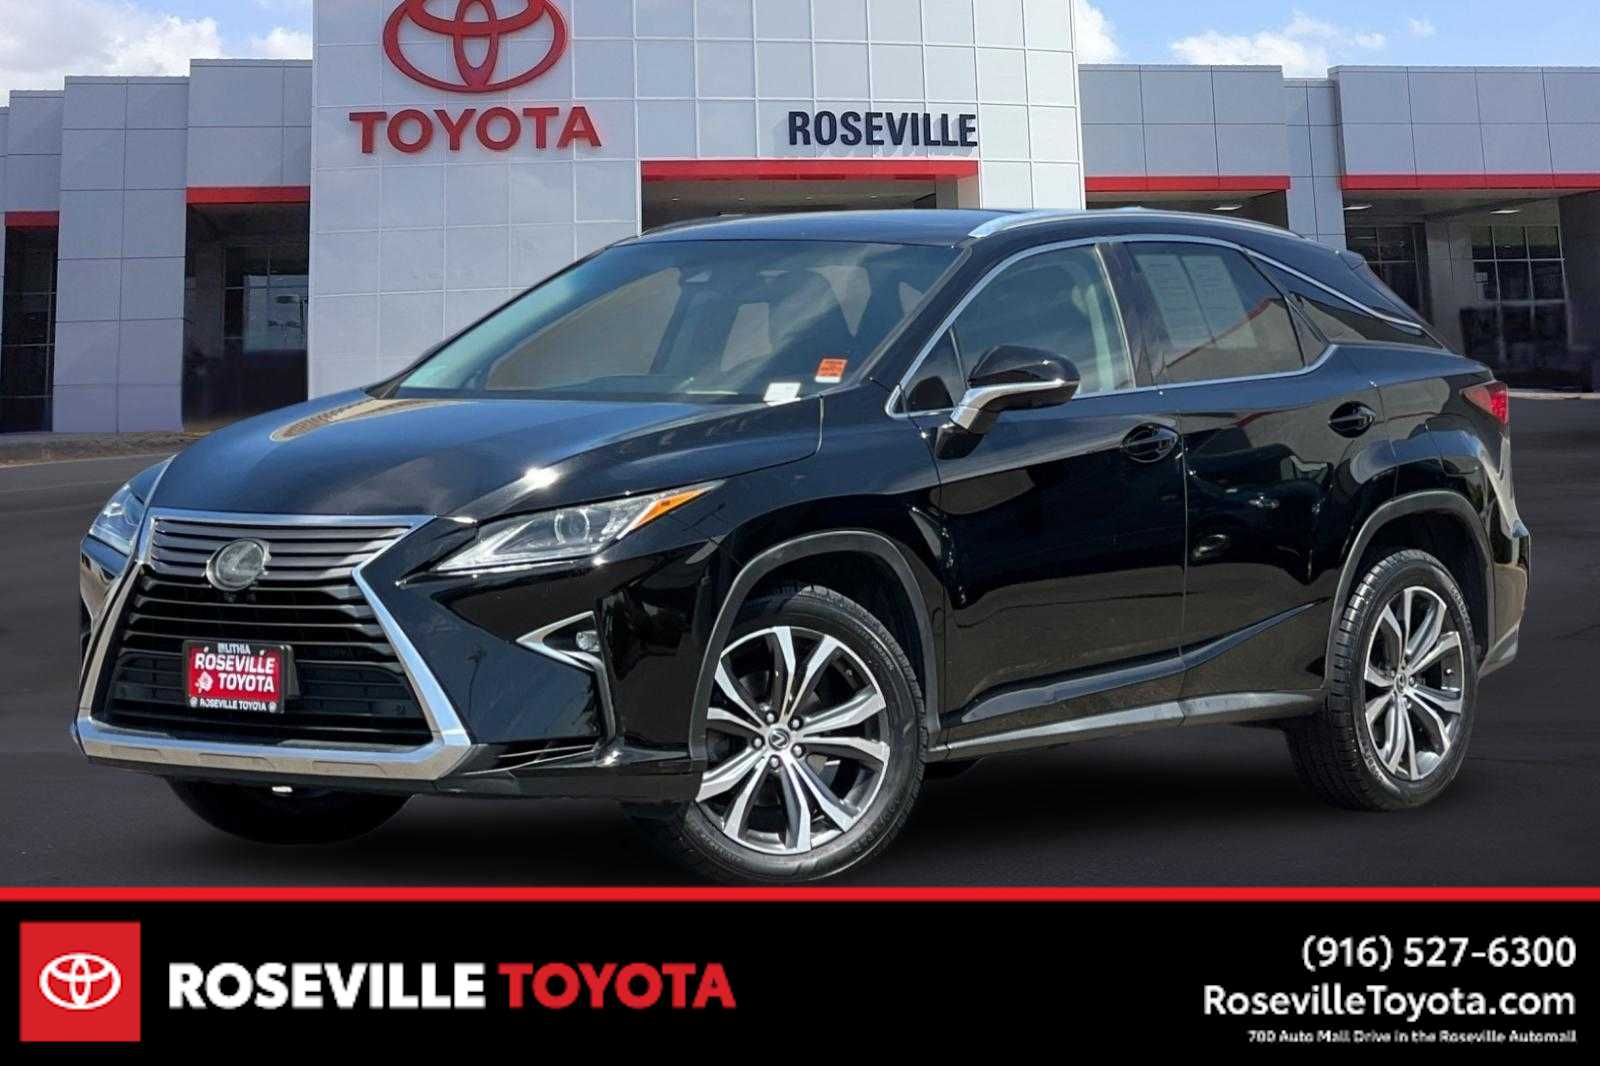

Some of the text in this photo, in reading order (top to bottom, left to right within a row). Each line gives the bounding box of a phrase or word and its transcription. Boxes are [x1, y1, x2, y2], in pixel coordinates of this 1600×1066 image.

[349, 106, 602, 154] TOYOTA
[788, 110, 978, 147] ROSEVILLE
[194, 652, 276, 674] ROSEVILLE
[218, 672, 275, 693] TOYOTA
[199, 698, 267, 711] ROSEVILLE TOYOTA
